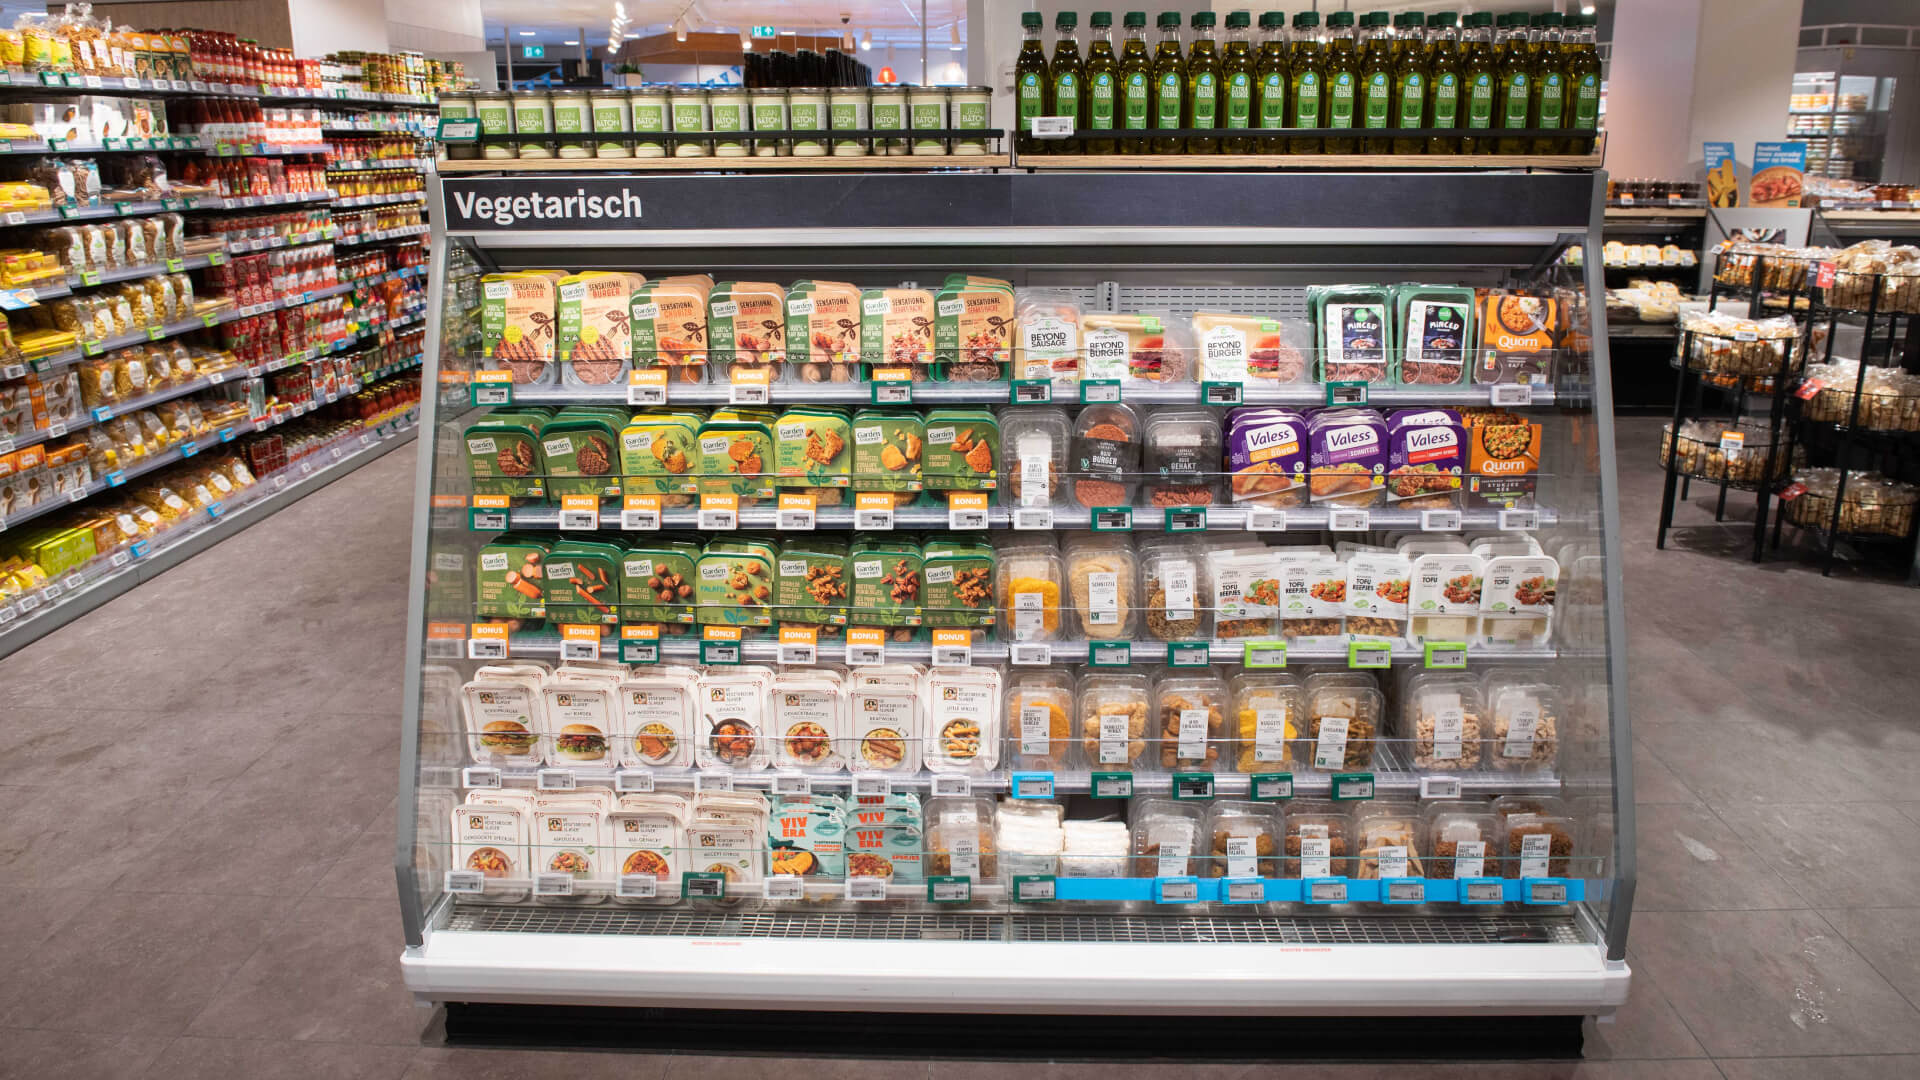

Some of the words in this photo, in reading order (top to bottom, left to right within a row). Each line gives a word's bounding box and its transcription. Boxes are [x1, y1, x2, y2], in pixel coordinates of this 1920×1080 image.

[454, 188, 642, 225] Vegetarisch
[513, 283, 546, 291] SENSATIONAL
[589, 281, 622, 290] SENSATIONAL
[517, 290, 544, 298] BURGER
[592, 288, 620, 297] BURGER
[660, 302, 693, 310] SENSATIONAL
[739, 300, 772, 308] SENSATIONAL
[816, 298, 849, 306] SENSATIONAL
[865, 301, 888, 310] Garden
[966, 298, 1000, 306] SENSATIONAL
[634, 305, 657, 314] Garden
[713, 304, 736, 313] Garden
[790, 302, 812, 311] Garden
[940, 303, 963, 311] Garden
[1347, 322, 1378, 330] MINCED
[1430, 322, 1460, 330] MINCED
[1031, 332, 1066, 341] BEYOND
[1032, 340, 1067, 348] SAUSAGE
[1090, 342, 1124, 350] BEYOND
[1208, 341, 1241, 349] BEYOND
[1498, 336, 1538, 349] Quorn
[1090, 349, 1124, 357] BURGER
[1209, 349, 1242, 358] BURGER
[635, 373, 662, 381] BONUS
[878, 372, 905, 380] BONUS
[780, 428, 804, 436] Garden
[929, 431, 954, 439] Garden
[625, 436, 650, 446] Garden
[1251, 430, 1289, 446] Valess
[1331, 432, 1370, 446] Valess
[1412, 433, 1450, 447] Valess
[470, 441, 494, 449] Garden
[546, 441, 571, 451] Garden
[703, 441, 727, 450] Garden
[1093, 456, 1117, 465] BURGER
[1482, 460, 1525, 474] Quorn
[479, 498, 505, 506] BONUS
[567, 498, 593, 506] BONUS
[629, 498, 655, 506] BONUS
[706, 497, 732, 505] BONUS
[784, 497, 810, 505] BONUS
[861, 497, 888, 505] BONUS
[954, 497, 981, 505] BONUS
[483, 557, 506, 565] Garden
[627, 563, 650, 571] Garden
[702, 567, 726, 575] Garden
[928, 570, 952, 578] Garden
[569, 628, 595, 636] BONUS
[784, 631, 811, 639] BONUS
[852, 632, 878, 640] BONUS
[938, 633, 964, 641] BONUS
[780, 816, 807, 828] VIV
[857, 812, 884, 824] VIV
[782, 829, 806, 838] ERA
[856, 830, 884, 840] VIV
[859, 840, 883, 848] ERA
